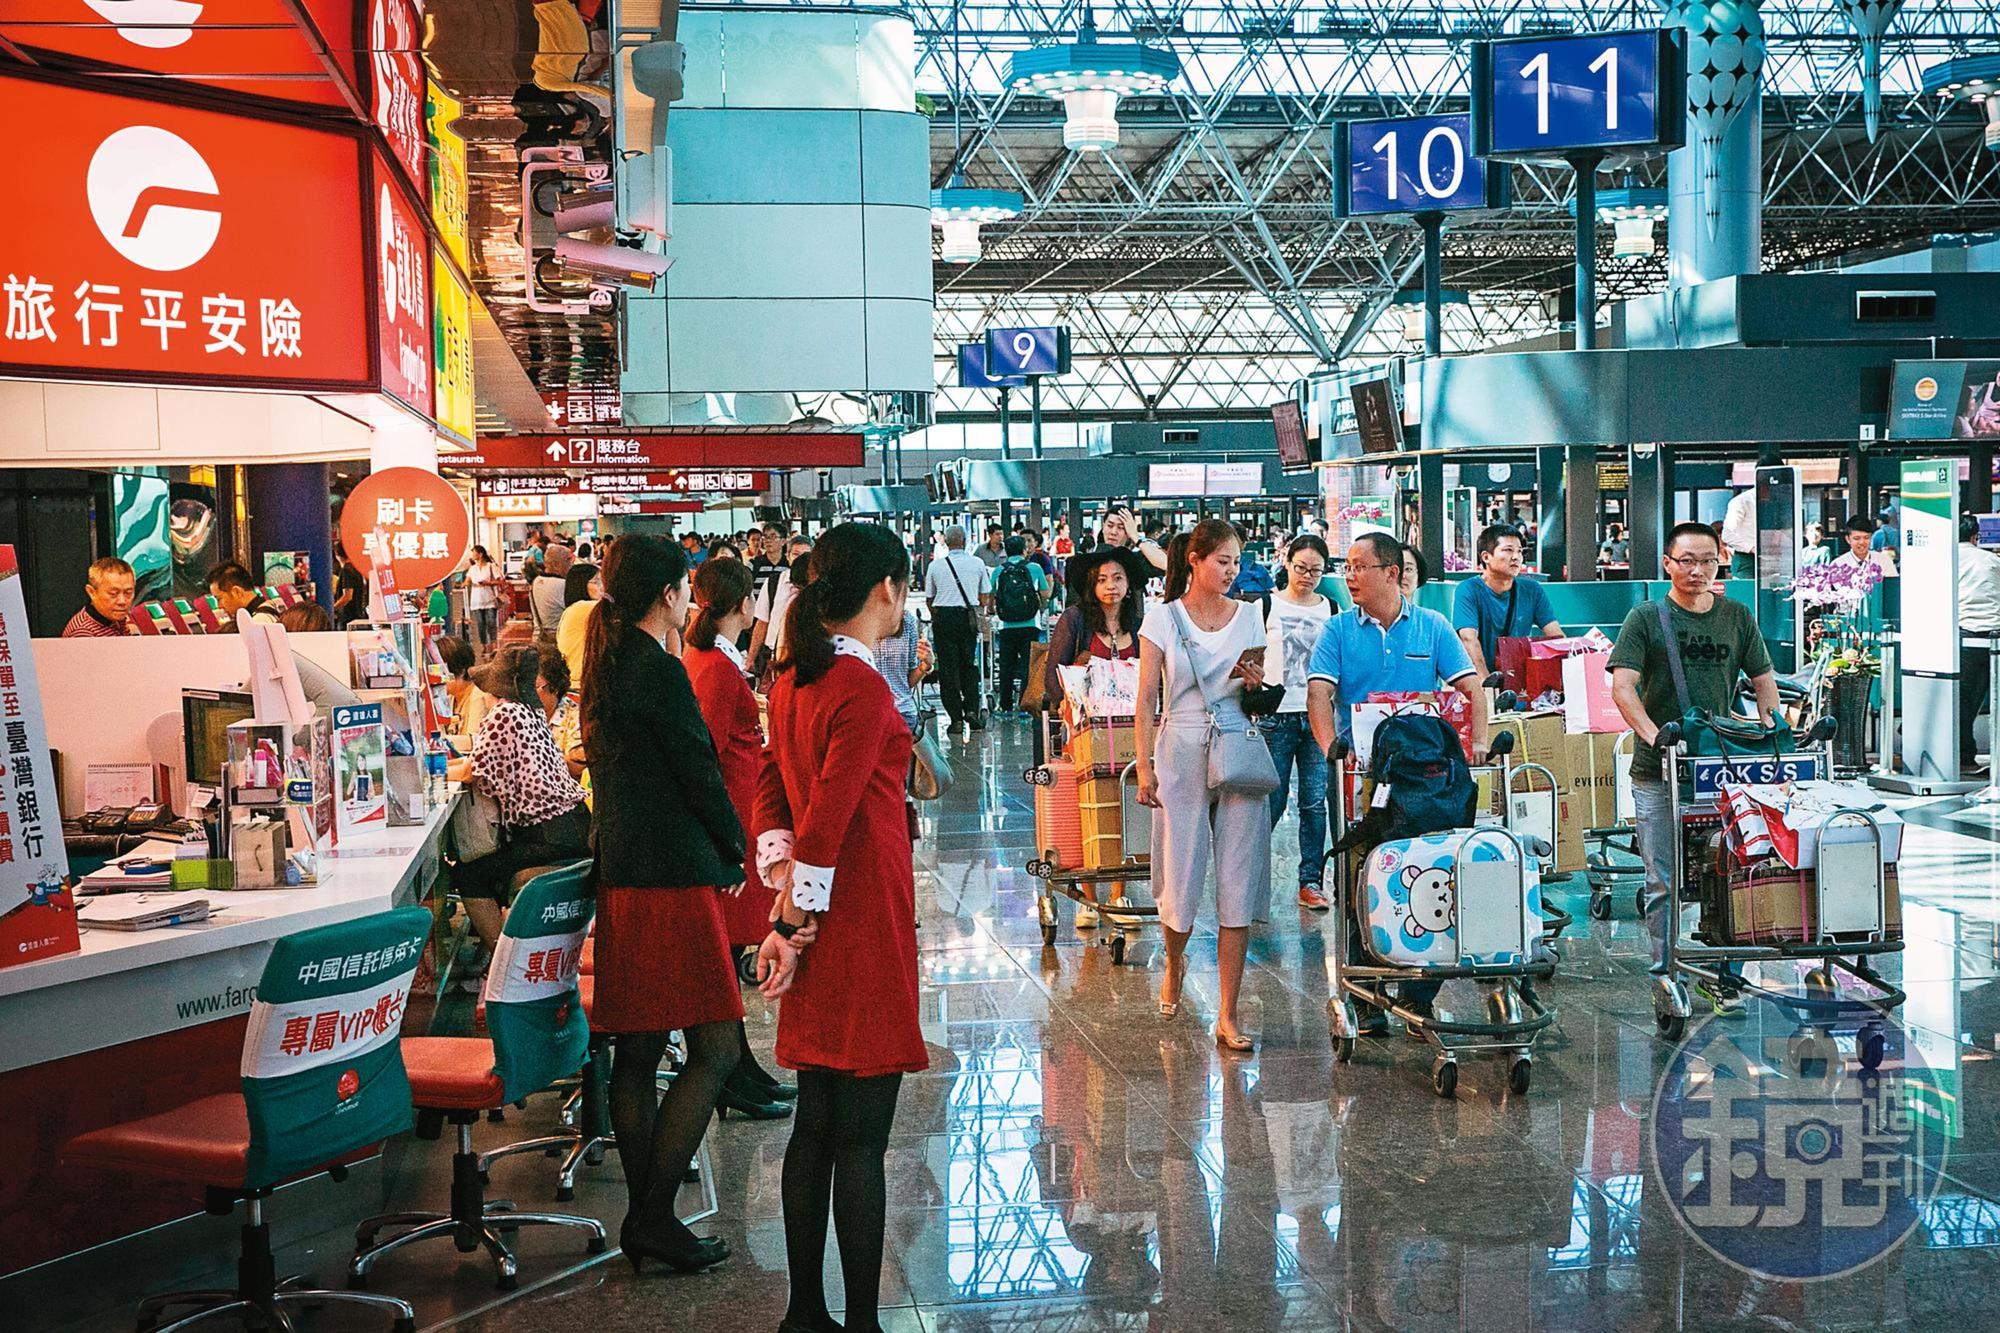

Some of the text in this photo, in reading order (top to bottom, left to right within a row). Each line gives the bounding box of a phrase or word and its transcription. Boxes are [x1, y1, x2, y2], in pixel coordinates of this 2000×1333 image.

[1520, 47, 1618, 135] 11
[1372, 126, 1465, 201] 10
[2, 273, 303, 359] 旅行平安險
[1013, 332, 1036, 369] 9
[438, 455, 485, 464] estaurants
[597, 439, 641, 454] 服務台
[597, 455, 649, 464] Information
[376, 497, 435, 526] 刷卡
[297, 935, 423, 986] 中國信託信用卡
